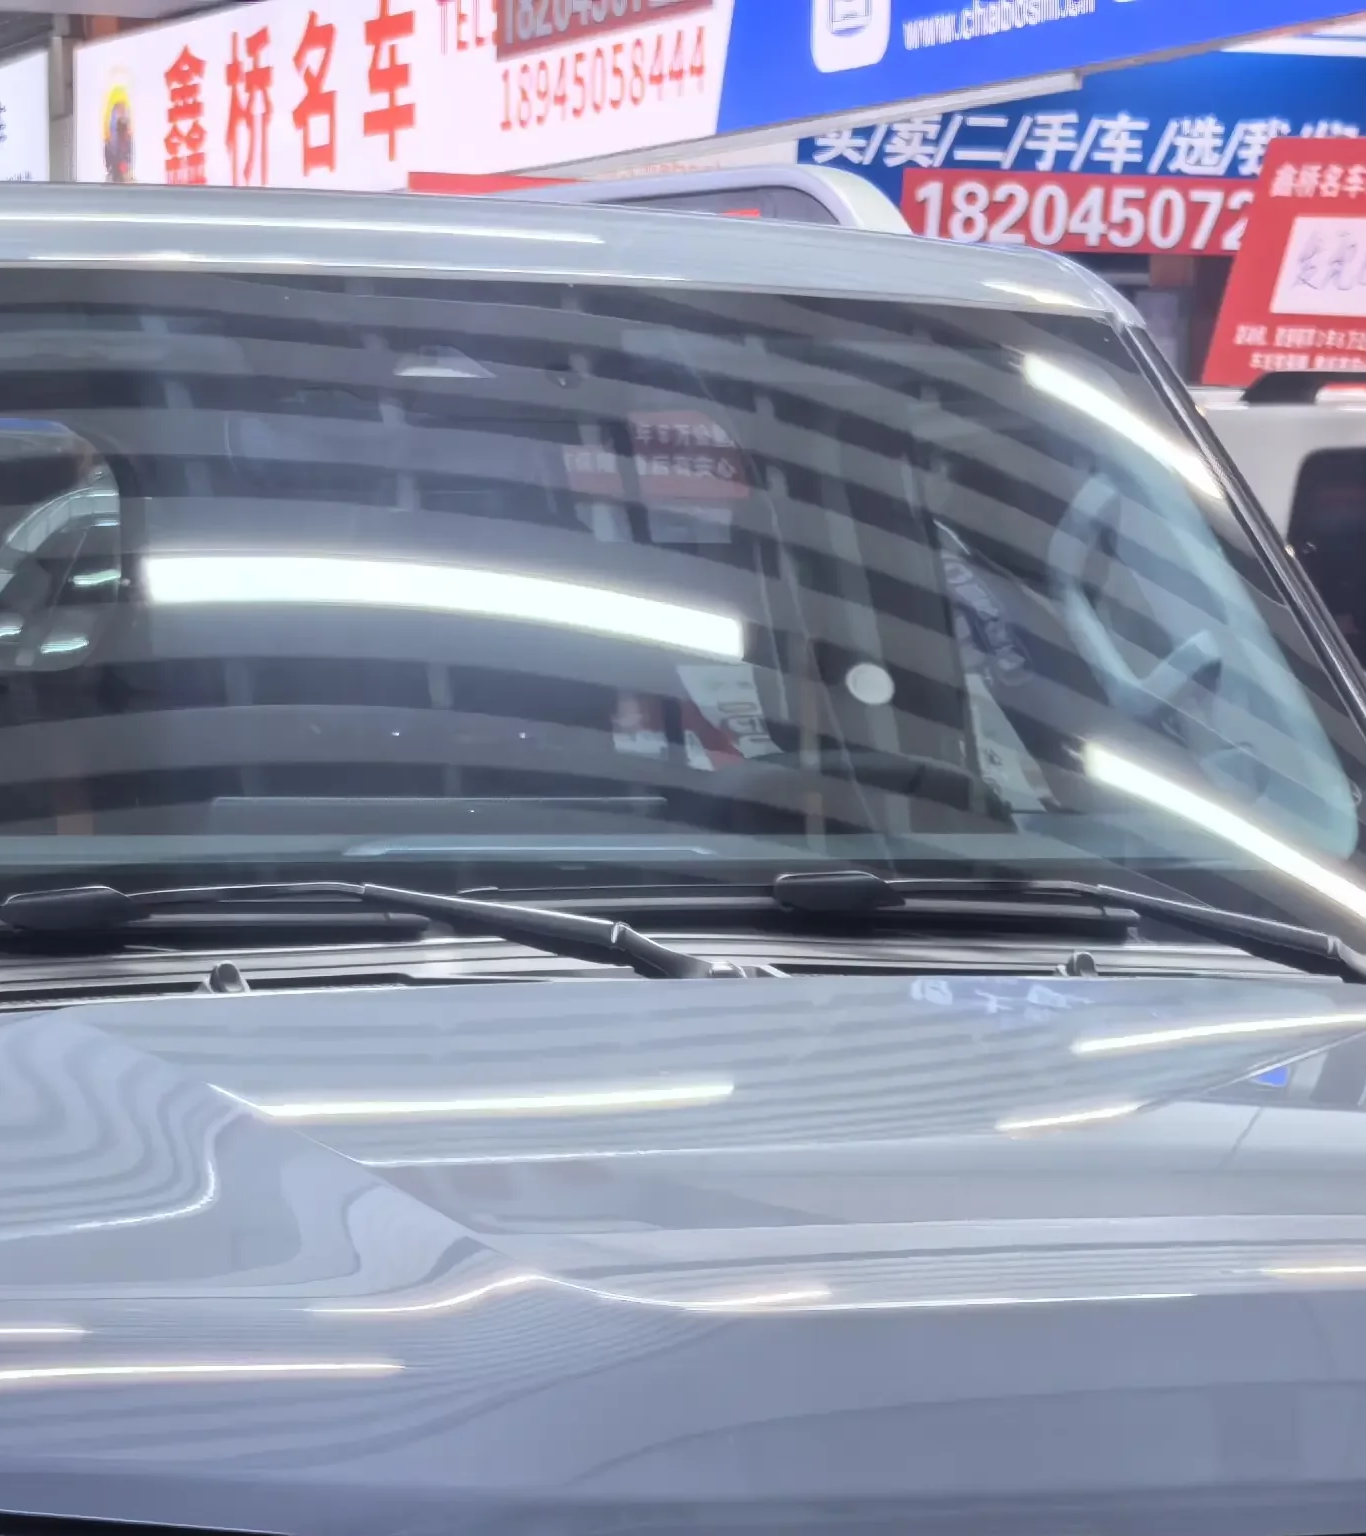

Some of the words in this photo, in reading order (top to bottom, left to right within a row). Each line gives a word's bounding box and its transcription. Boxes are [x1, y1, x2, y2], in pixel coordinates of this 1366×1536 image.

[164, 0, 415, 186] 鑫桥名车
[499, 25, 708, 132] 18945058444
